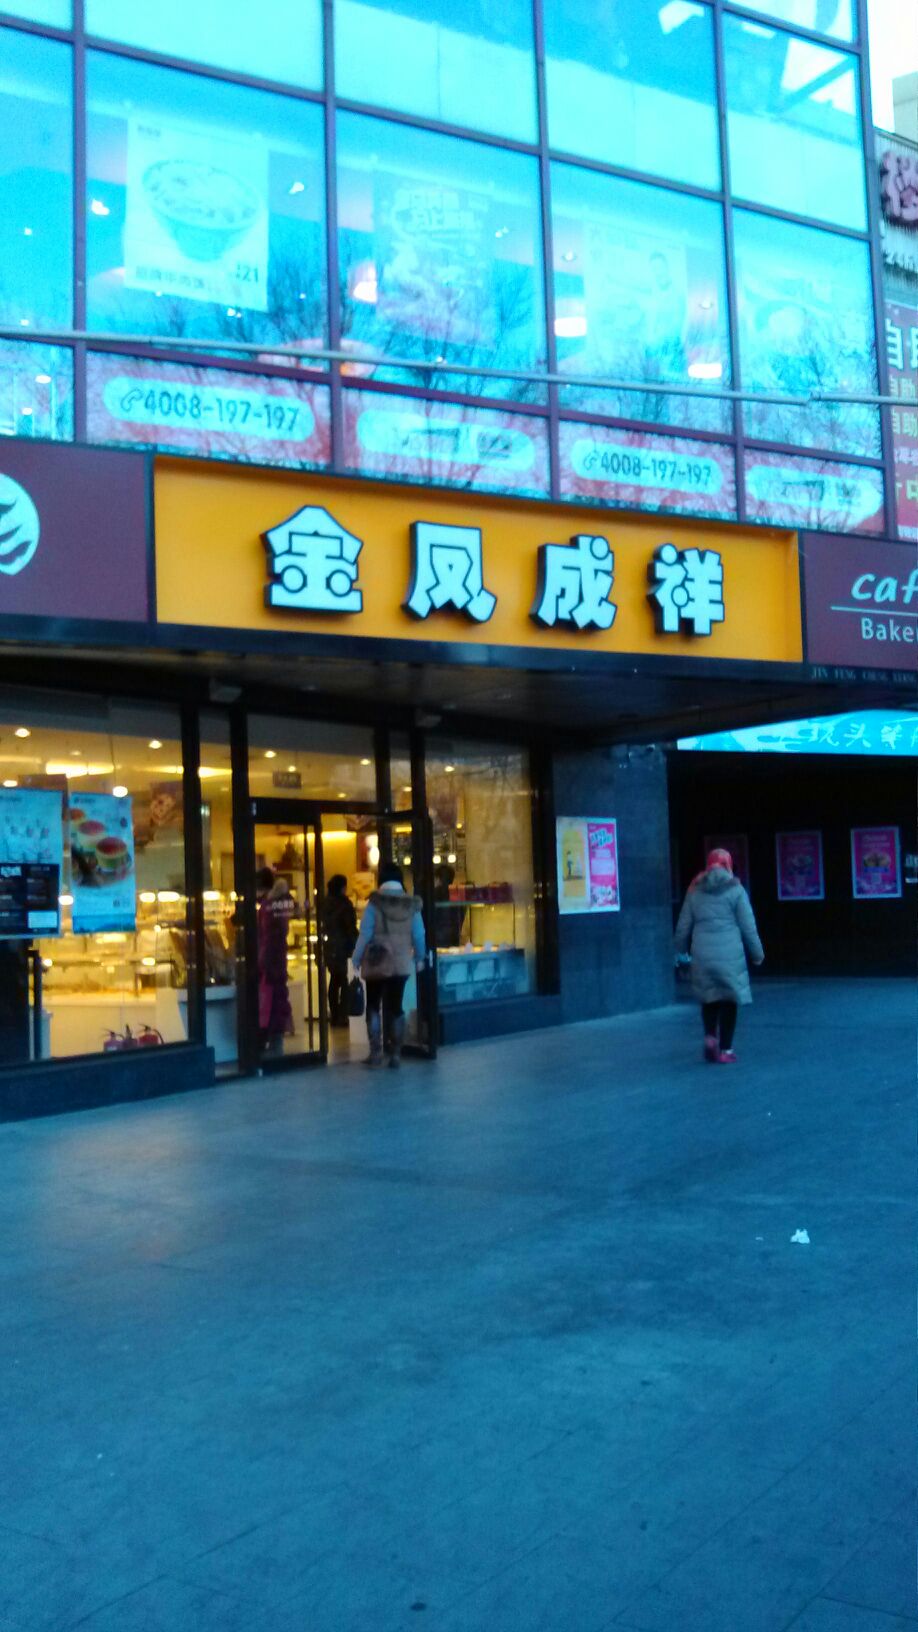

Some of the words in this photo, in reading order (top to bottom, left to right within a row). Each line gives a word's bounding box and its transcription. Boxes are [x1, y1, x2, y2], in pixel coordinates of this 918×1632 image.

[144, 388, 300, 432] 4008-197-197
[600, 451, 711, 486] 4008-197-197
[260, 504, 726, 636] 金凤成祥
[860, 616, 918, 643] Bake
